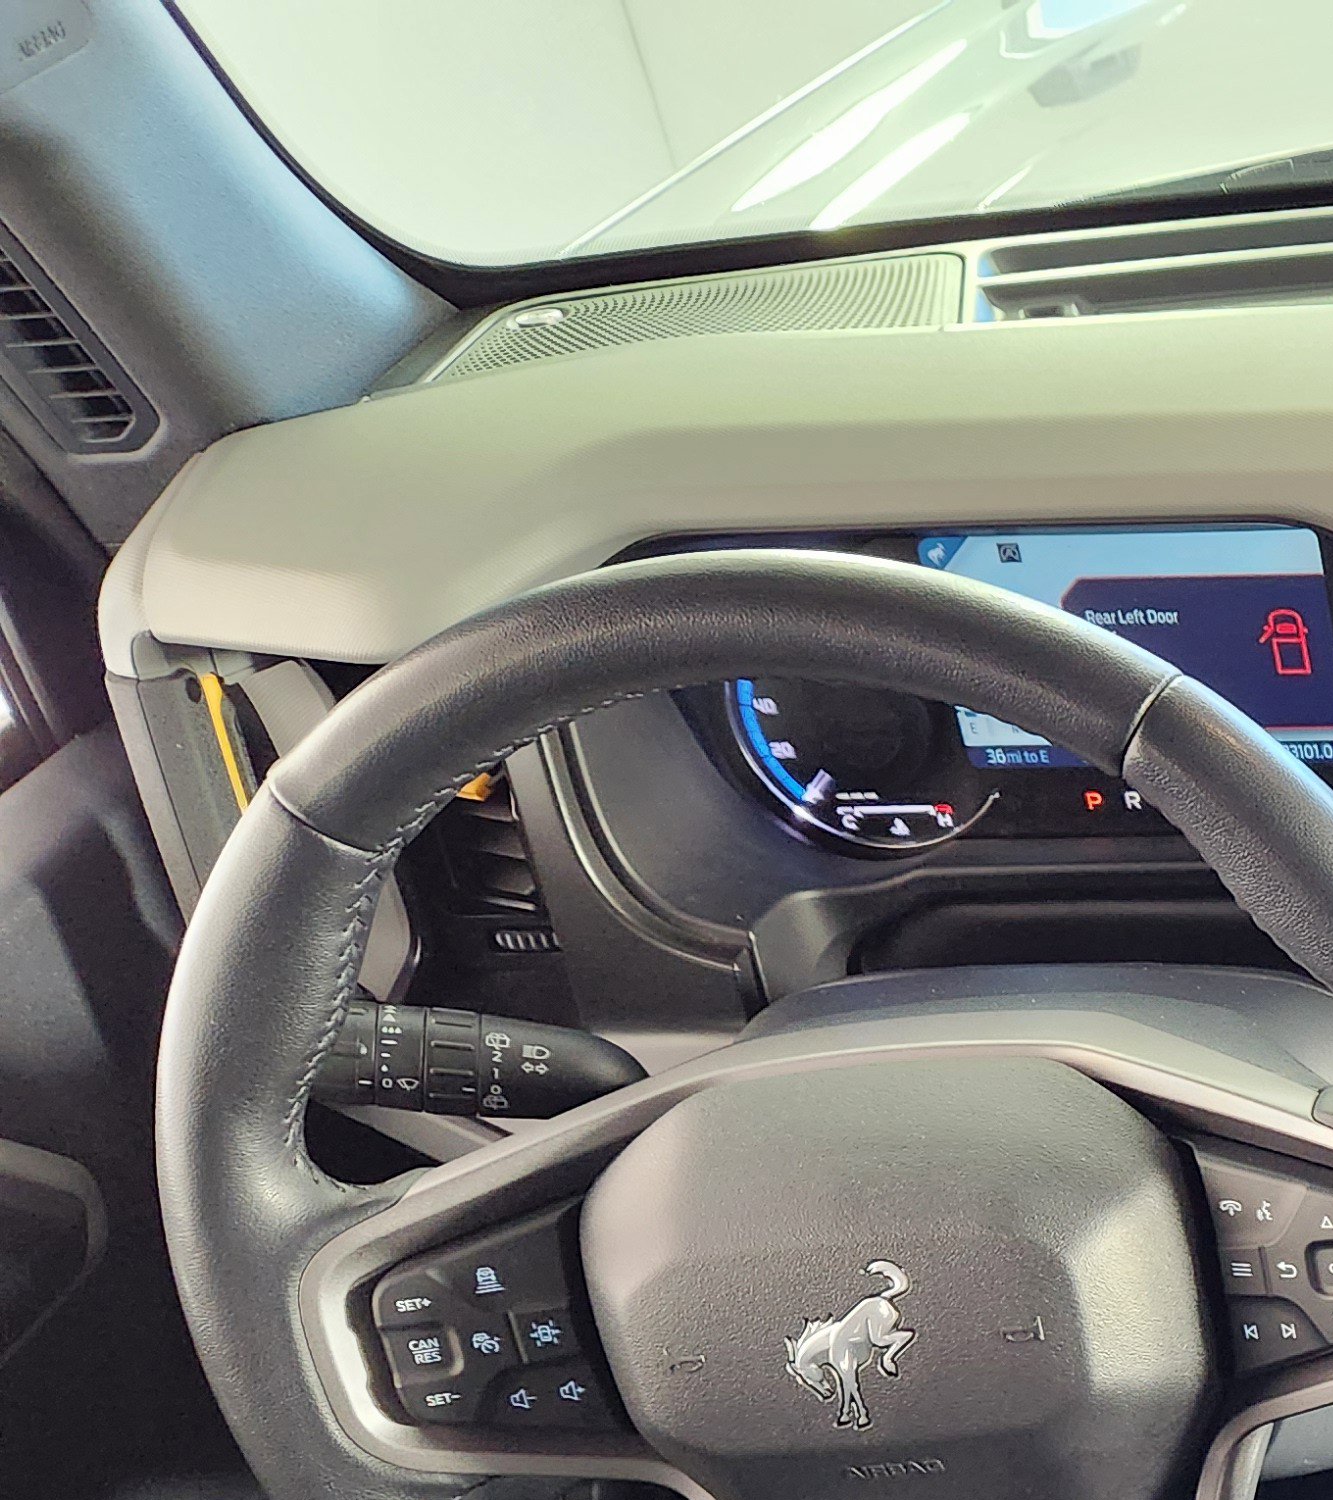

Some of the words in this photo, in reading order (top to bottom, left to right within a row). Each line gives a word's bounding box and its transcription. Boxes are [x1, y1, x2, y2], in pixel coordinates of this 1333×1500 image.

[1085, 609, 1116, 626] Rear
[1117, 608, 1146, 625] Left
[1146, 608, 1179, 625] Door
[1024, 750, 1038, 763] to
[1040, 749, 1050, 764] E
[1084, 791, 1103, 810] P
[1123, 790, 1143, 810] R
[491, 1050, 502, 1063] 2
[395, 1297, 432, 1312] SET+
[408, 1337, 440, 1351] CAN
[414, 1351, 442, 1365] RES
